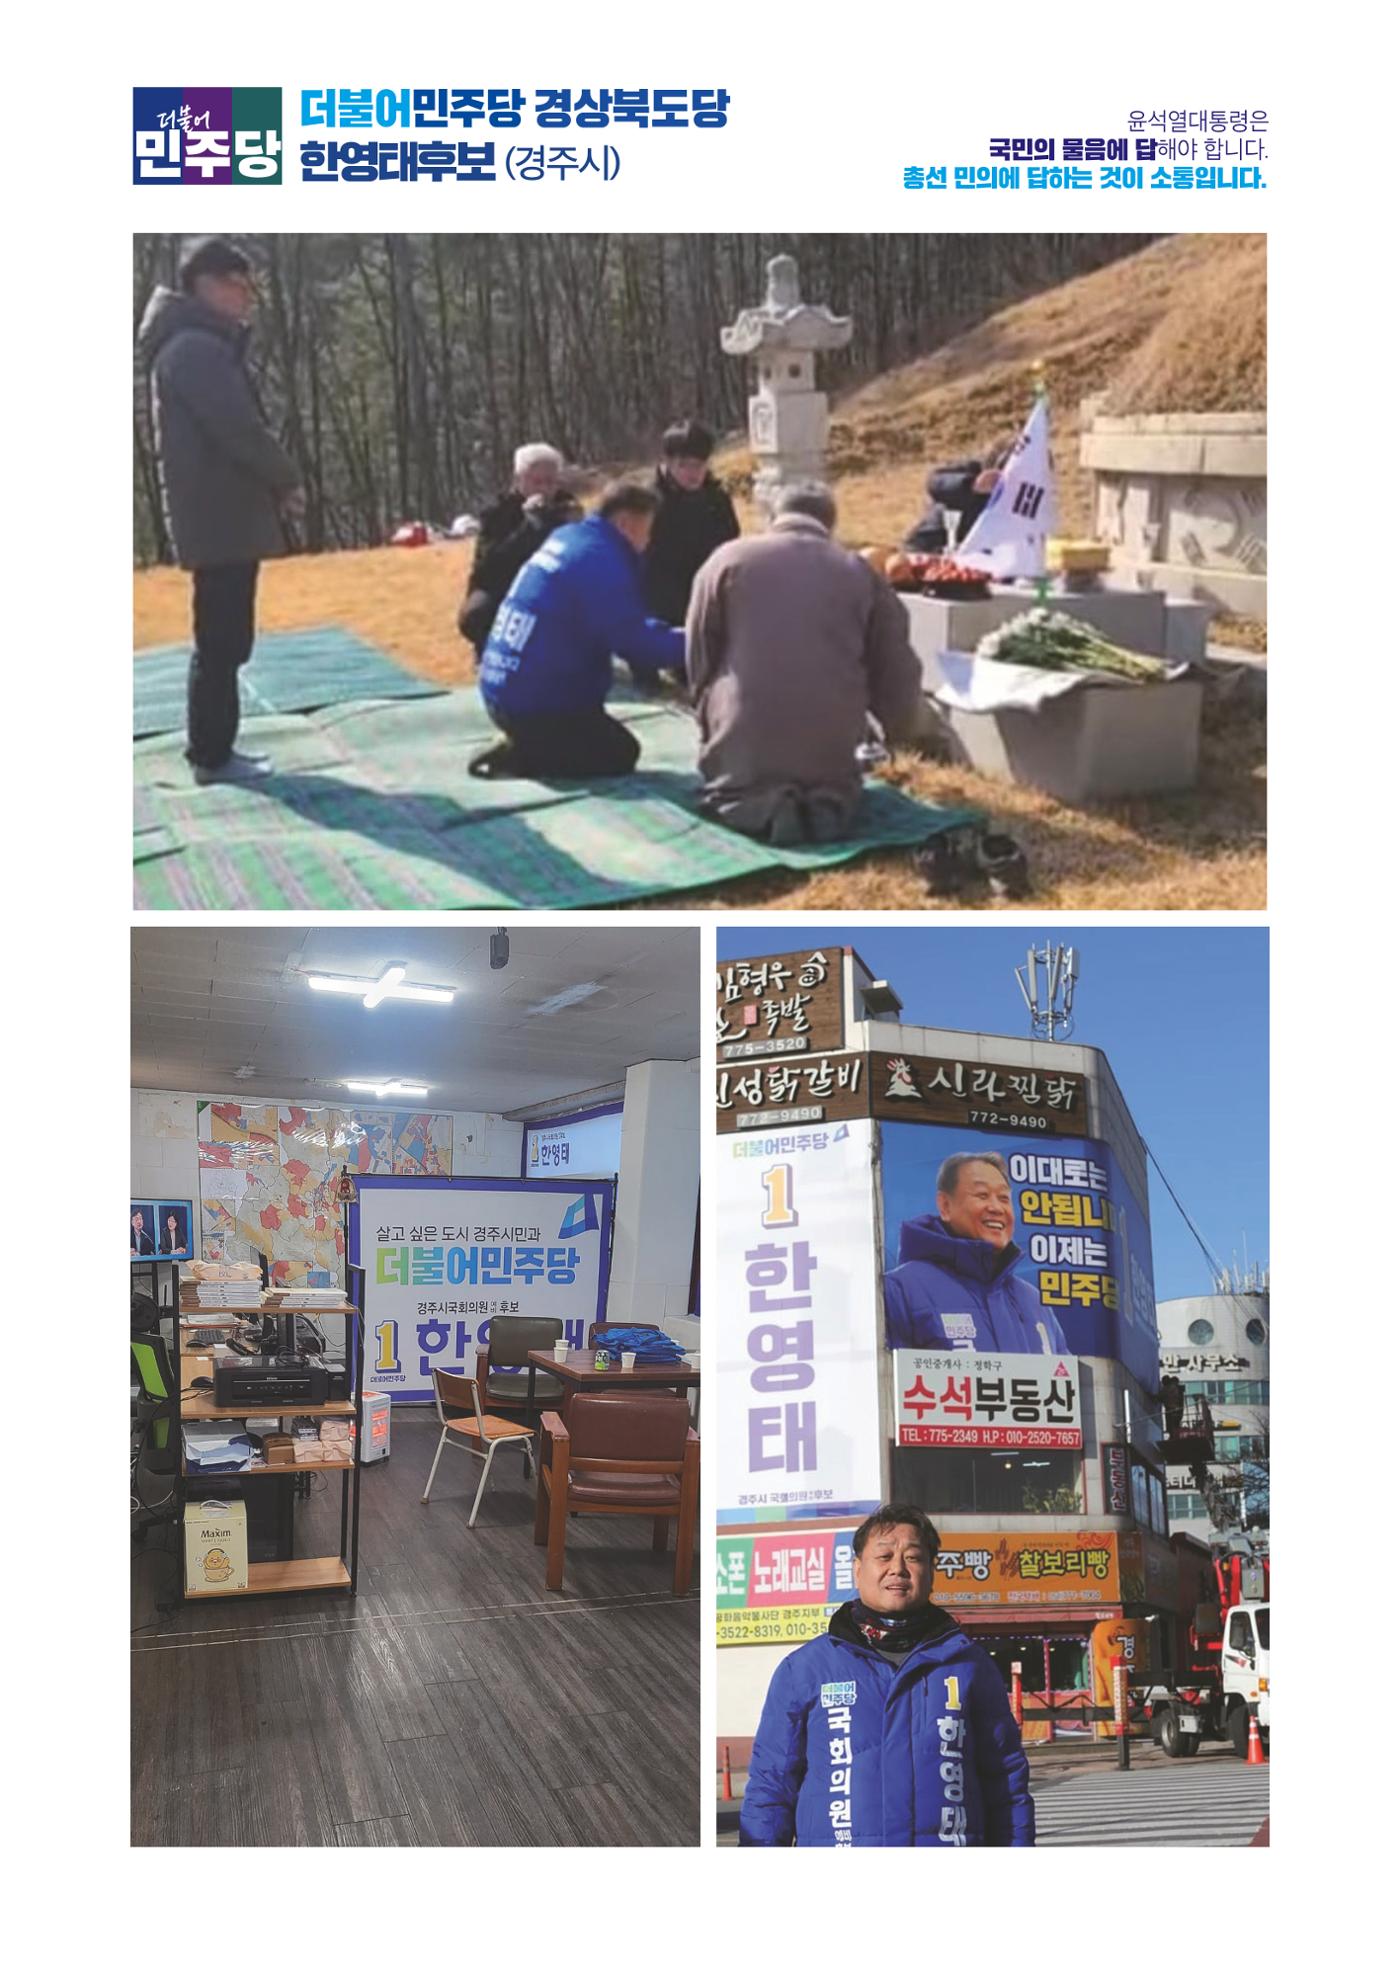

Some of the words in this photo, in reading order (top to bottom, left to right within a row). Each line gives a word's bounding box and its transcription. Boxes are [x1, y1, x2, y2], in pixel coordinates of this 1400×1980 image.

[762, 994, 811, 1036] 족발
[725, 1036, 806, 1057] 775-3520
[928, 1062, 1076, 1110] 신라찜닭
[738, 1107, 821, 1127] 772-9490
[970, 1110, 1047, 1129] 772-9490
[541, 1143, 570, 1167] 한영태
[732, 1132, 829, 1159] 더불어민주당
[1009, 1154, 1108, 1191] 이대로는
[761, 1163, 799, 1230] 1
[376, 1226, 405, 1242] 살고
[410, 1226, 438, 1242] 싶은
[442, 1226, 469, 1242] 도시
[473, 1226, 541, 1242] 경주시민과
[1030, 1234, 1108, 1267] 이제는
[376, 1246, 581, 1286] 더불어민주당
[417, 1301, 489, 1315] 경주시국회의원
[500, 1301, 519, 1314] 후보
[375, 1319, 401, 1374] 1
[744, 1241, 818, 1474] 한영태
[903, 1375, 1076, 1423] 수석부동산
[201, 1528, 231, 1538] Maxim
[754, 1547, 825, 1594] 노래교실
[936, 1550, 991, 1580] 주빵
[1018, 1549, 1110, 1580] 찰보리빵
[944, 1676, 962, 1711] 1
[828, 1707, 852, 1829] 국회의원
[937, 1716, 967, 1847] 한영태
